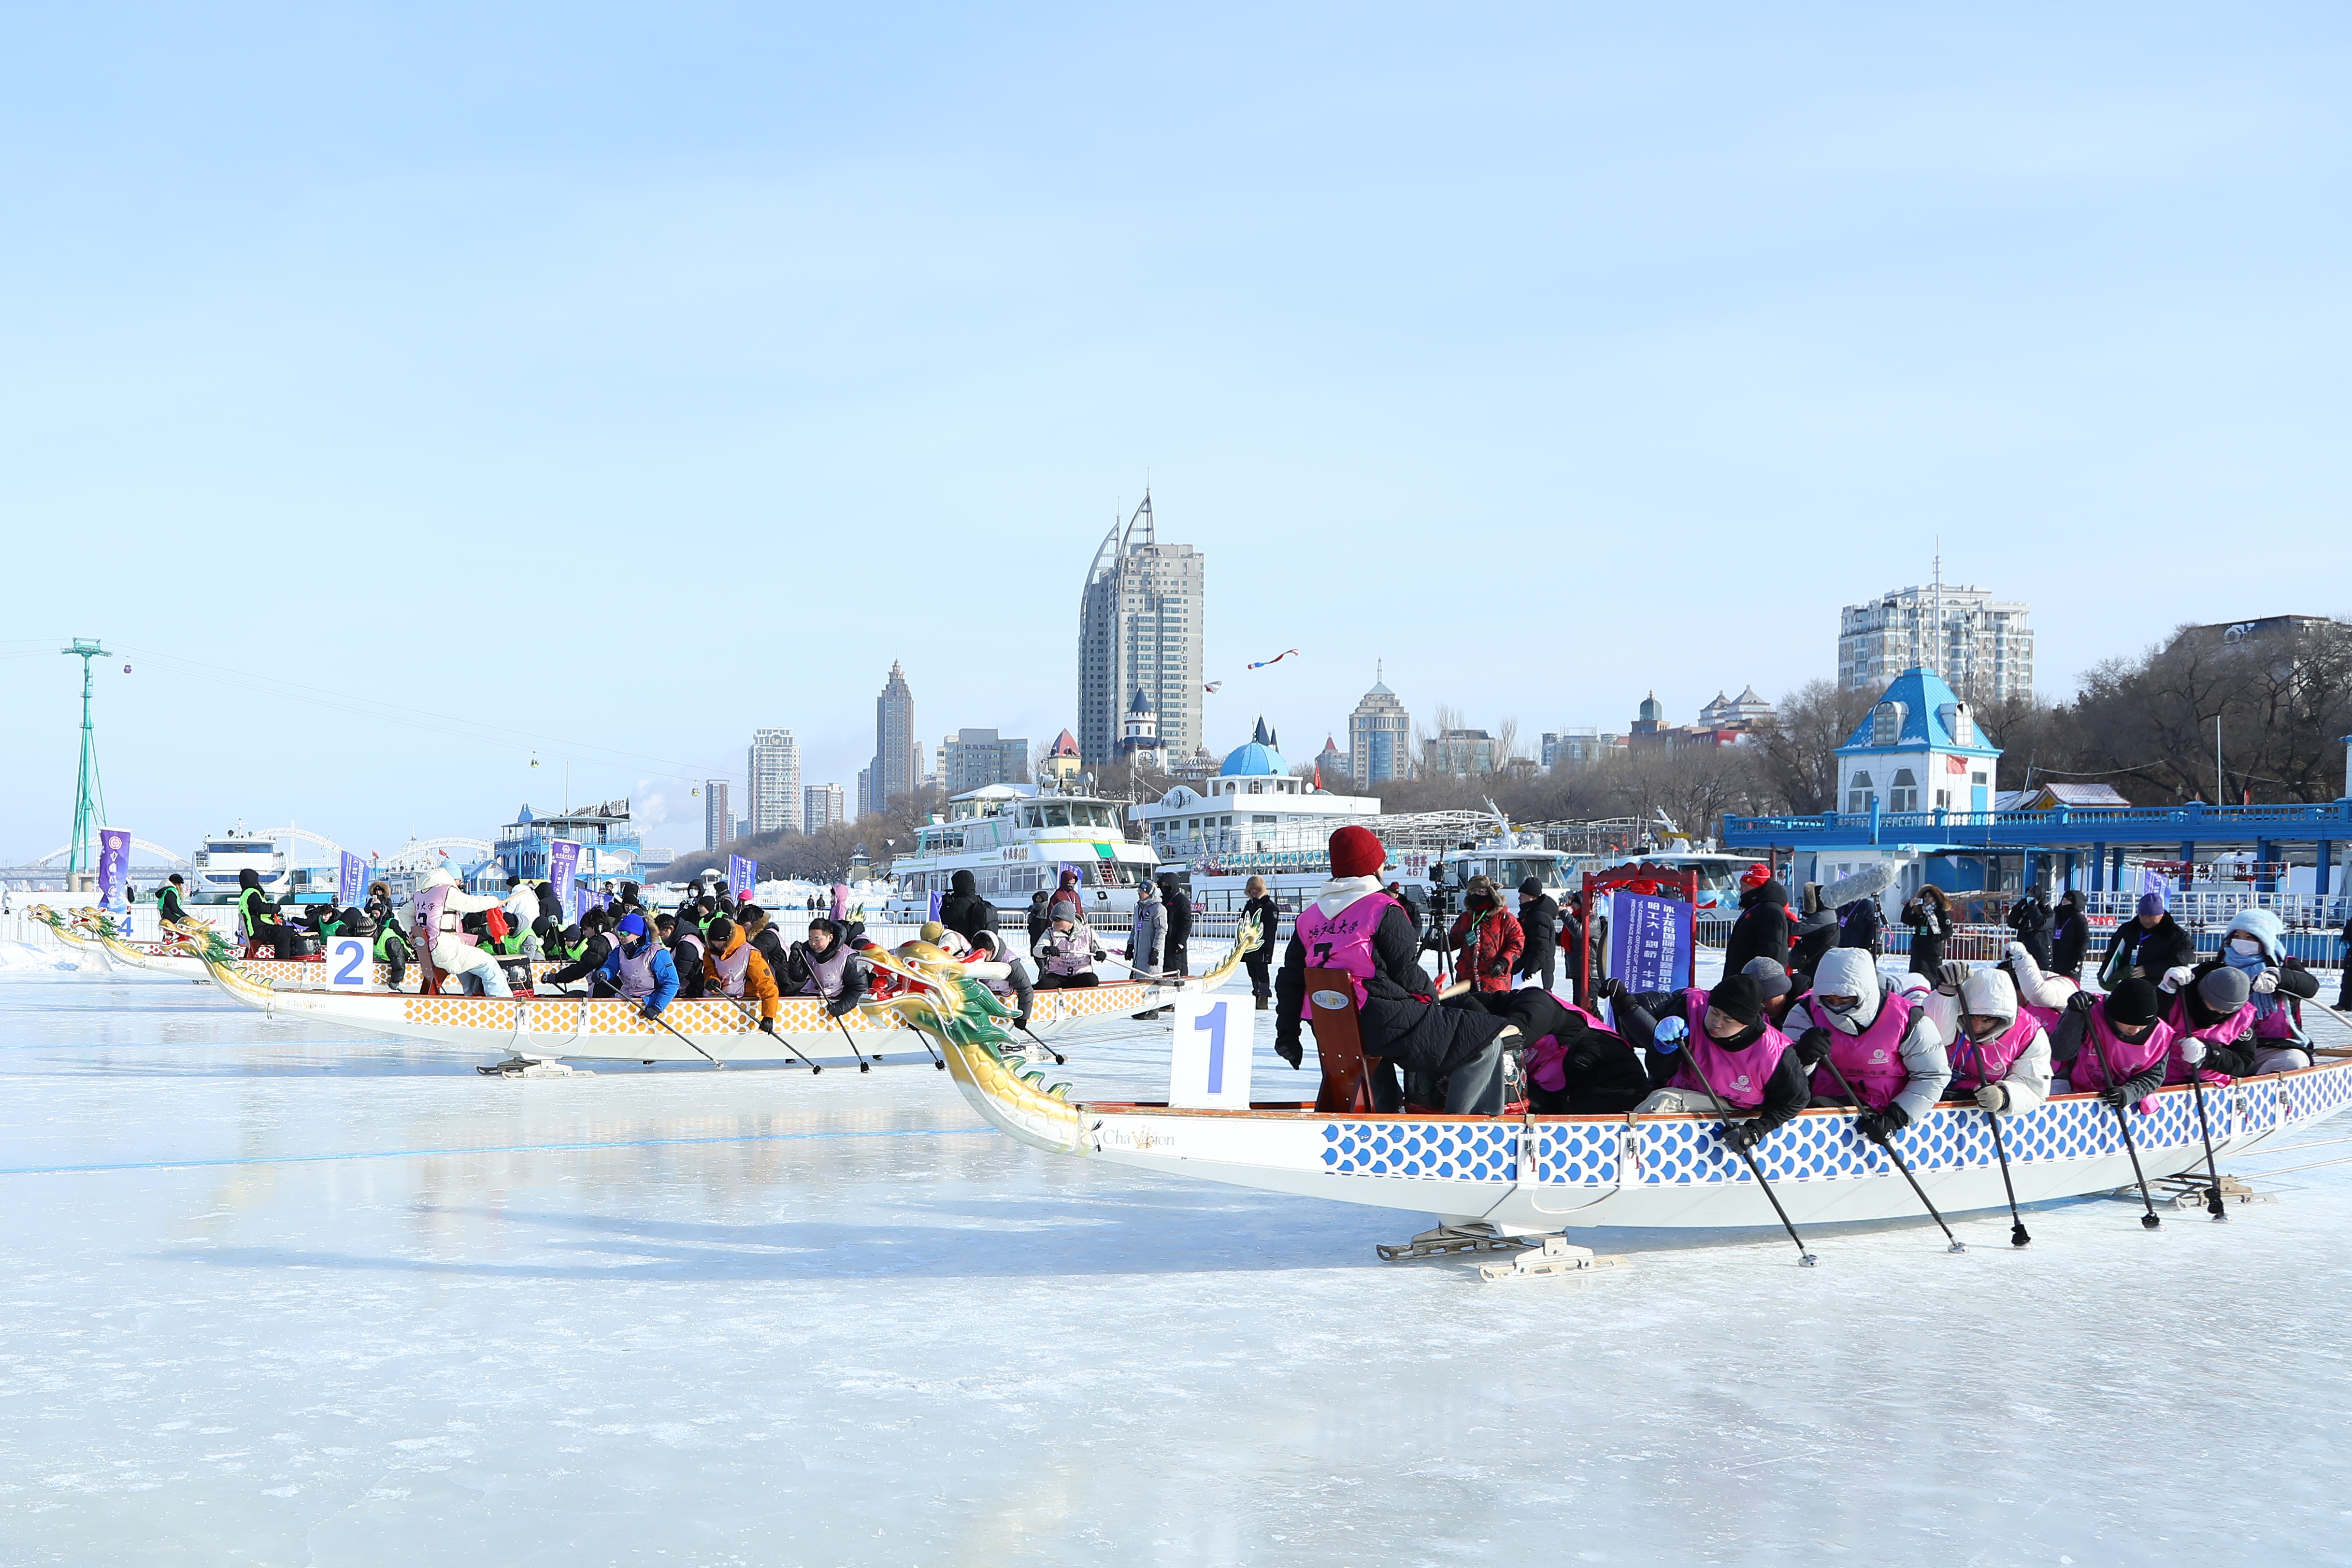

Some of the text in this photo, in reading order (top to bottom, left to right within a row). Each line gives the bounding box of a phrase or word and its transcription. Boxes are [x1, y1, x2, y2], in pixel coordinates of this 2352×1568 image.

[1406, 868, 1424, 877] 467
[117, 916, 133, 937] 4
[333, 940, 364, 985] 2
[1066, 967, 1074, 975] 9
[1194, 1001, 1227, 1094] 1
